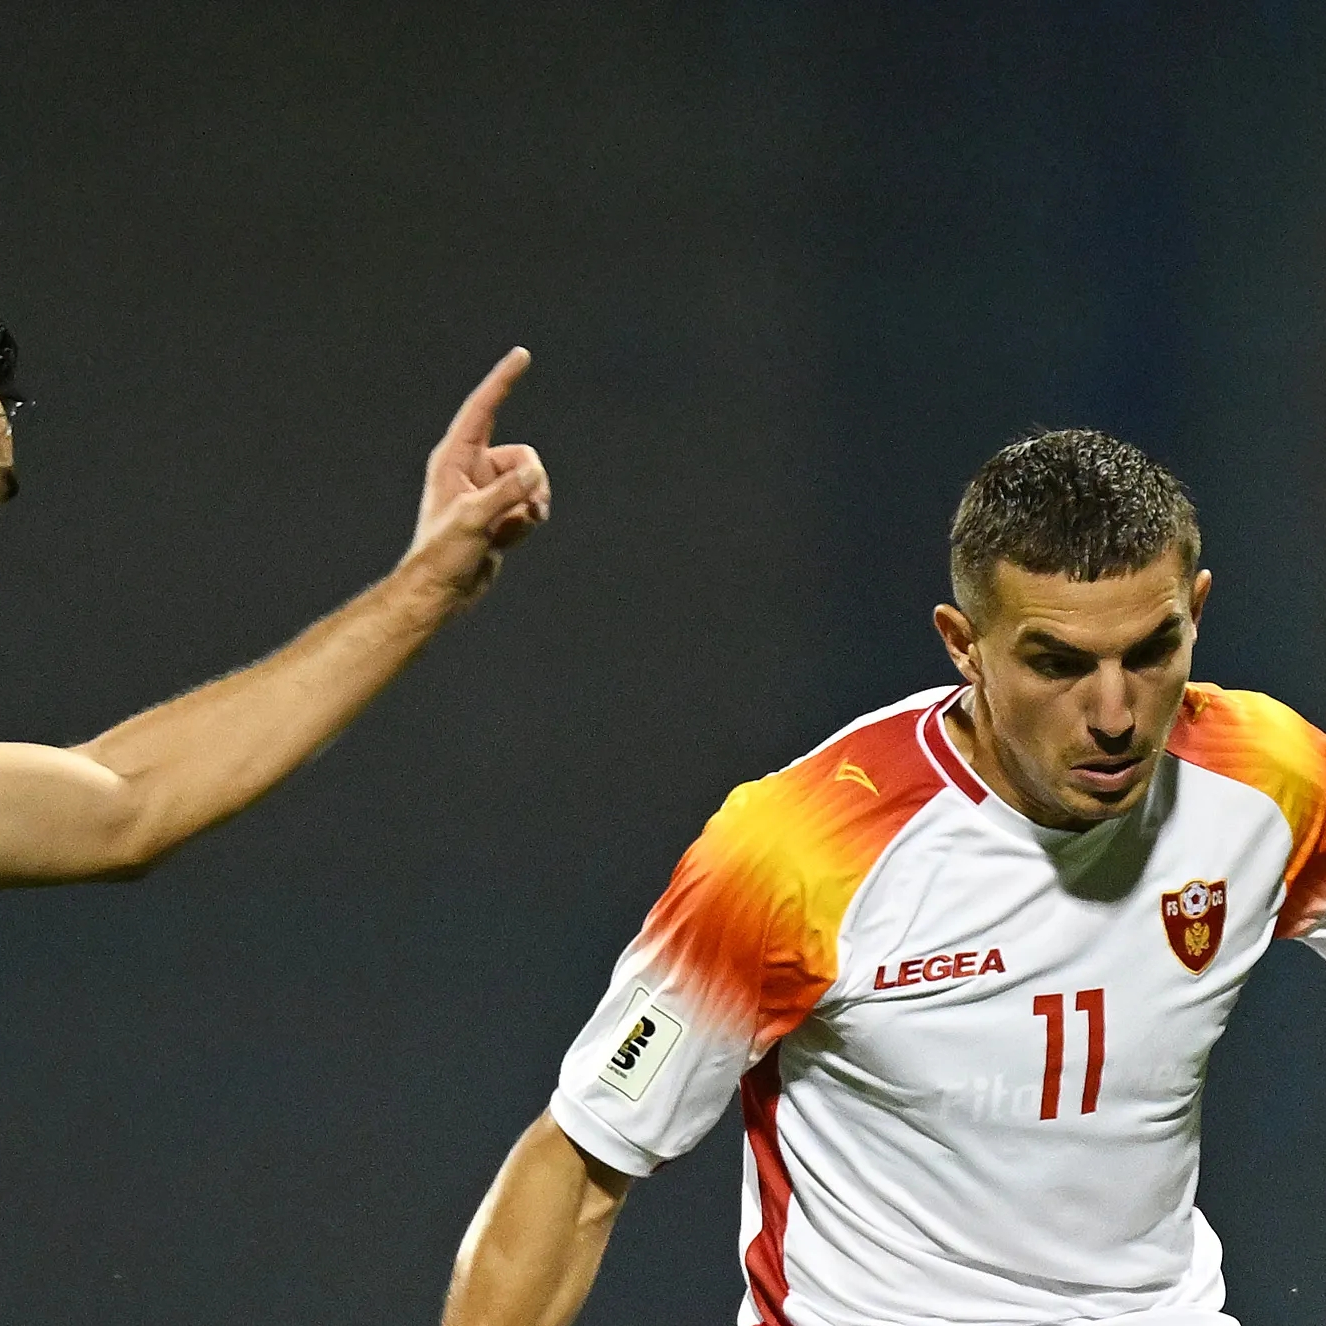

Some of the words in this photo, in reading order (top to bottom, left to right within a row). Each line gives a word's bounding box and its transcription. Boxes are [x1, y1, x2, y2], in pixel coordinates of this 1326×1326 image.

[1166, 900, 1179, 917] FS
[873, 948, 1006, 990] LEGEA
[1033, 987, 1105, 1120] 11
